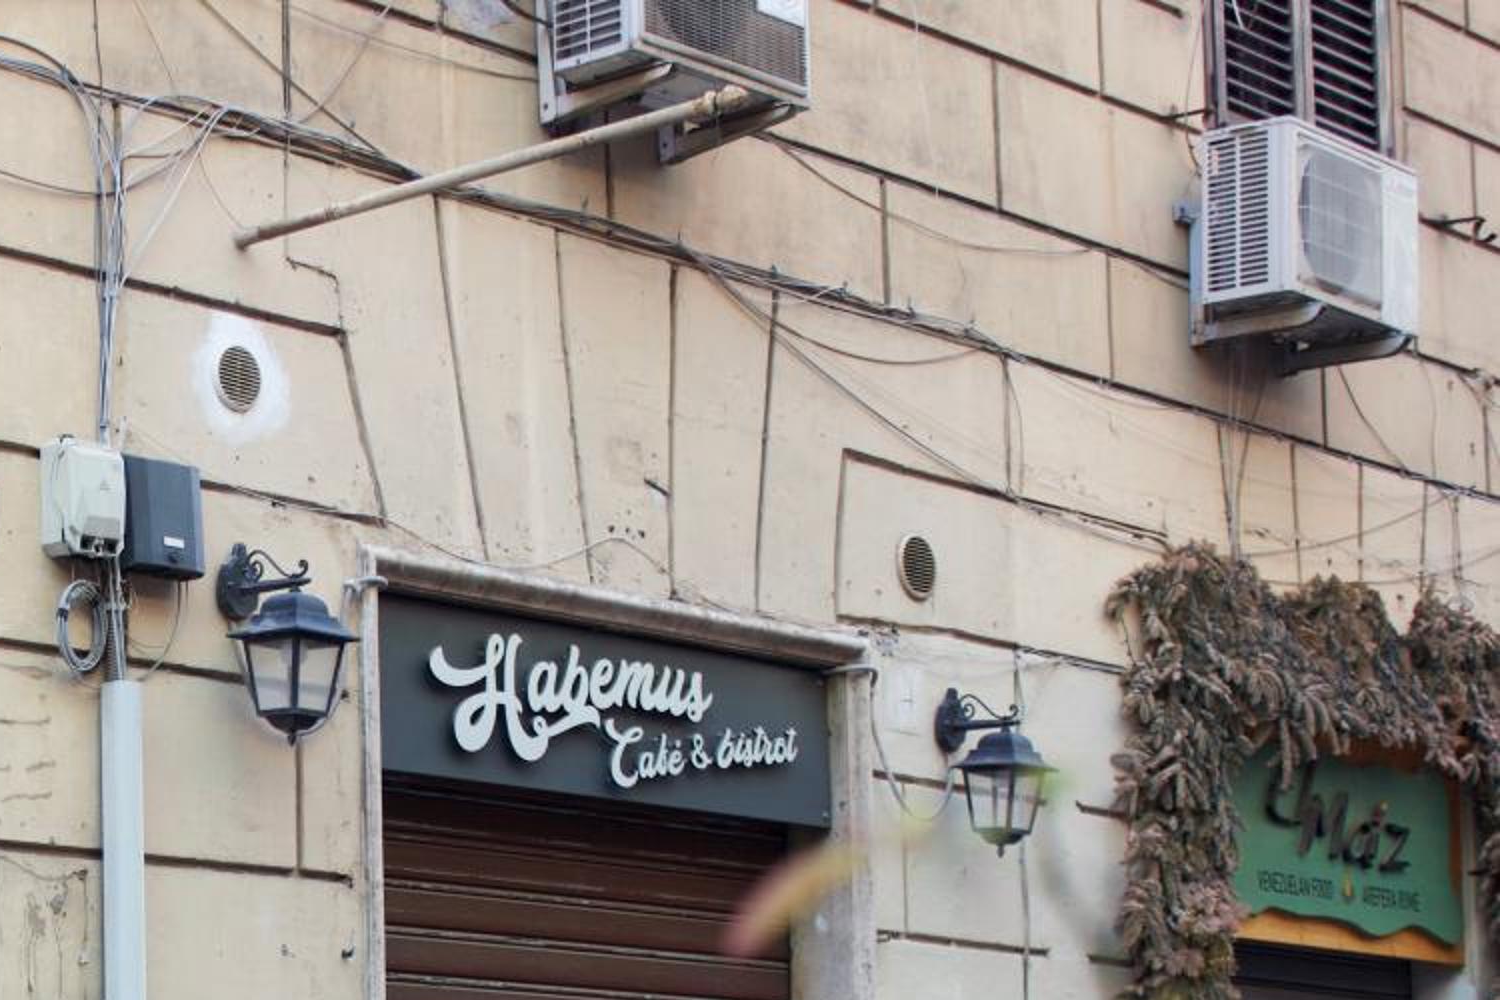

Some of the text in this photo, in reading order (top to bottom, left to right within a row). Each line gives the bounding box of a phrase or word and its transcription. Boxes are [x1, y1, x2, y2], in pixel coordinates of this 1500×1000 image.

[429, 632, 714, 763] Habemus
[690, 734, 712, 769] &
[716, 725, 799, 769] bistrot
